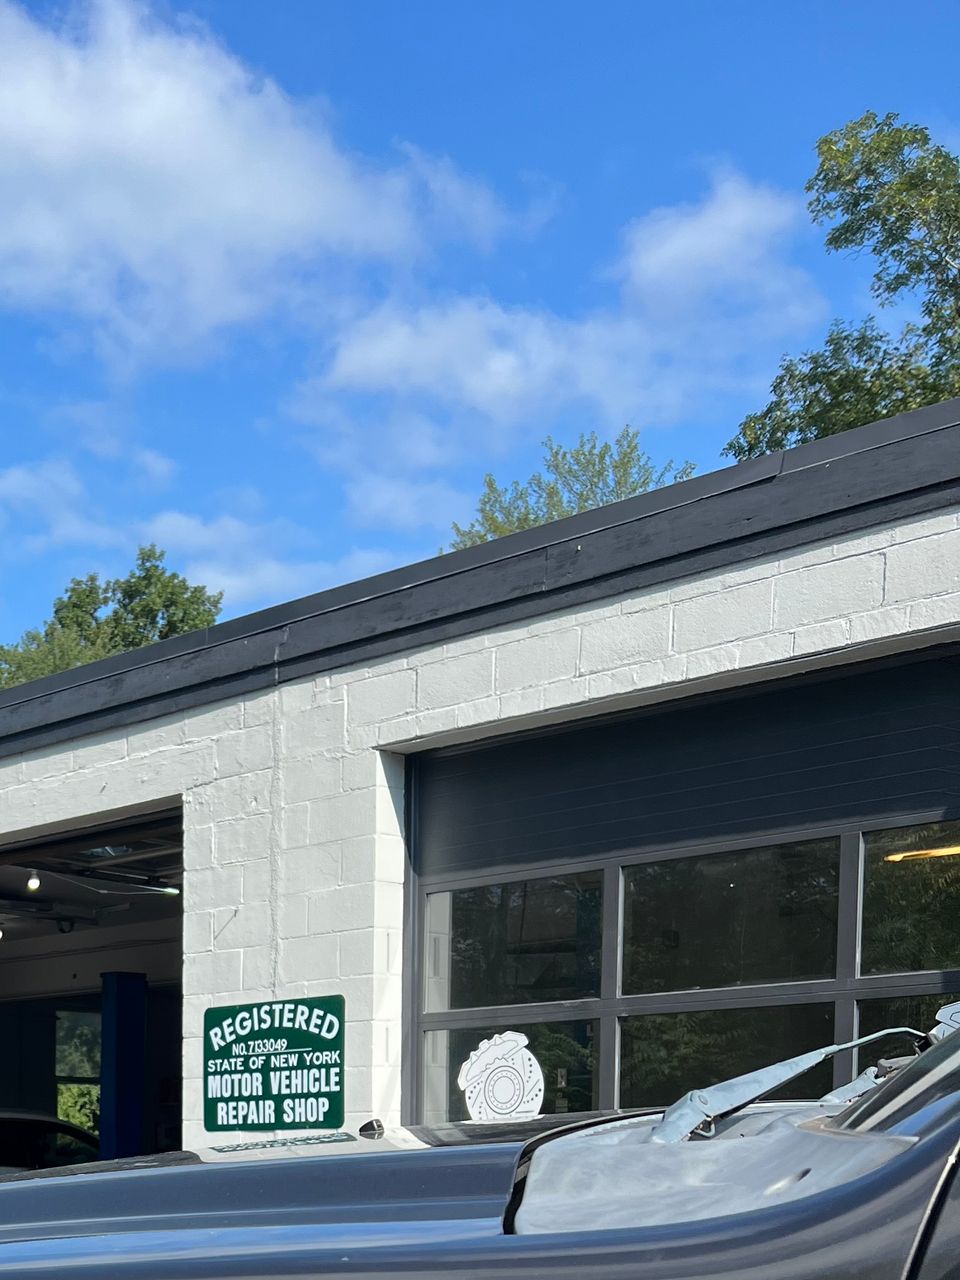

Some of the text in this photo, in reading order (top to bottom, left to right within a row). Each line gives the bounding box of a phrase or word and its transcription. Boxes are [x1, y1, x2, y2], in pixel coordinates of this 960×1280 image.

[209, 1003, 340, 1051] REGISTERED
[208, 1050, 340, 1072] STATE OF NEW YORK
[208, 1067, 340, 1098] MOTOR VEHICLE
[217, 1097, 329, 1125] REPAIR SHOP
